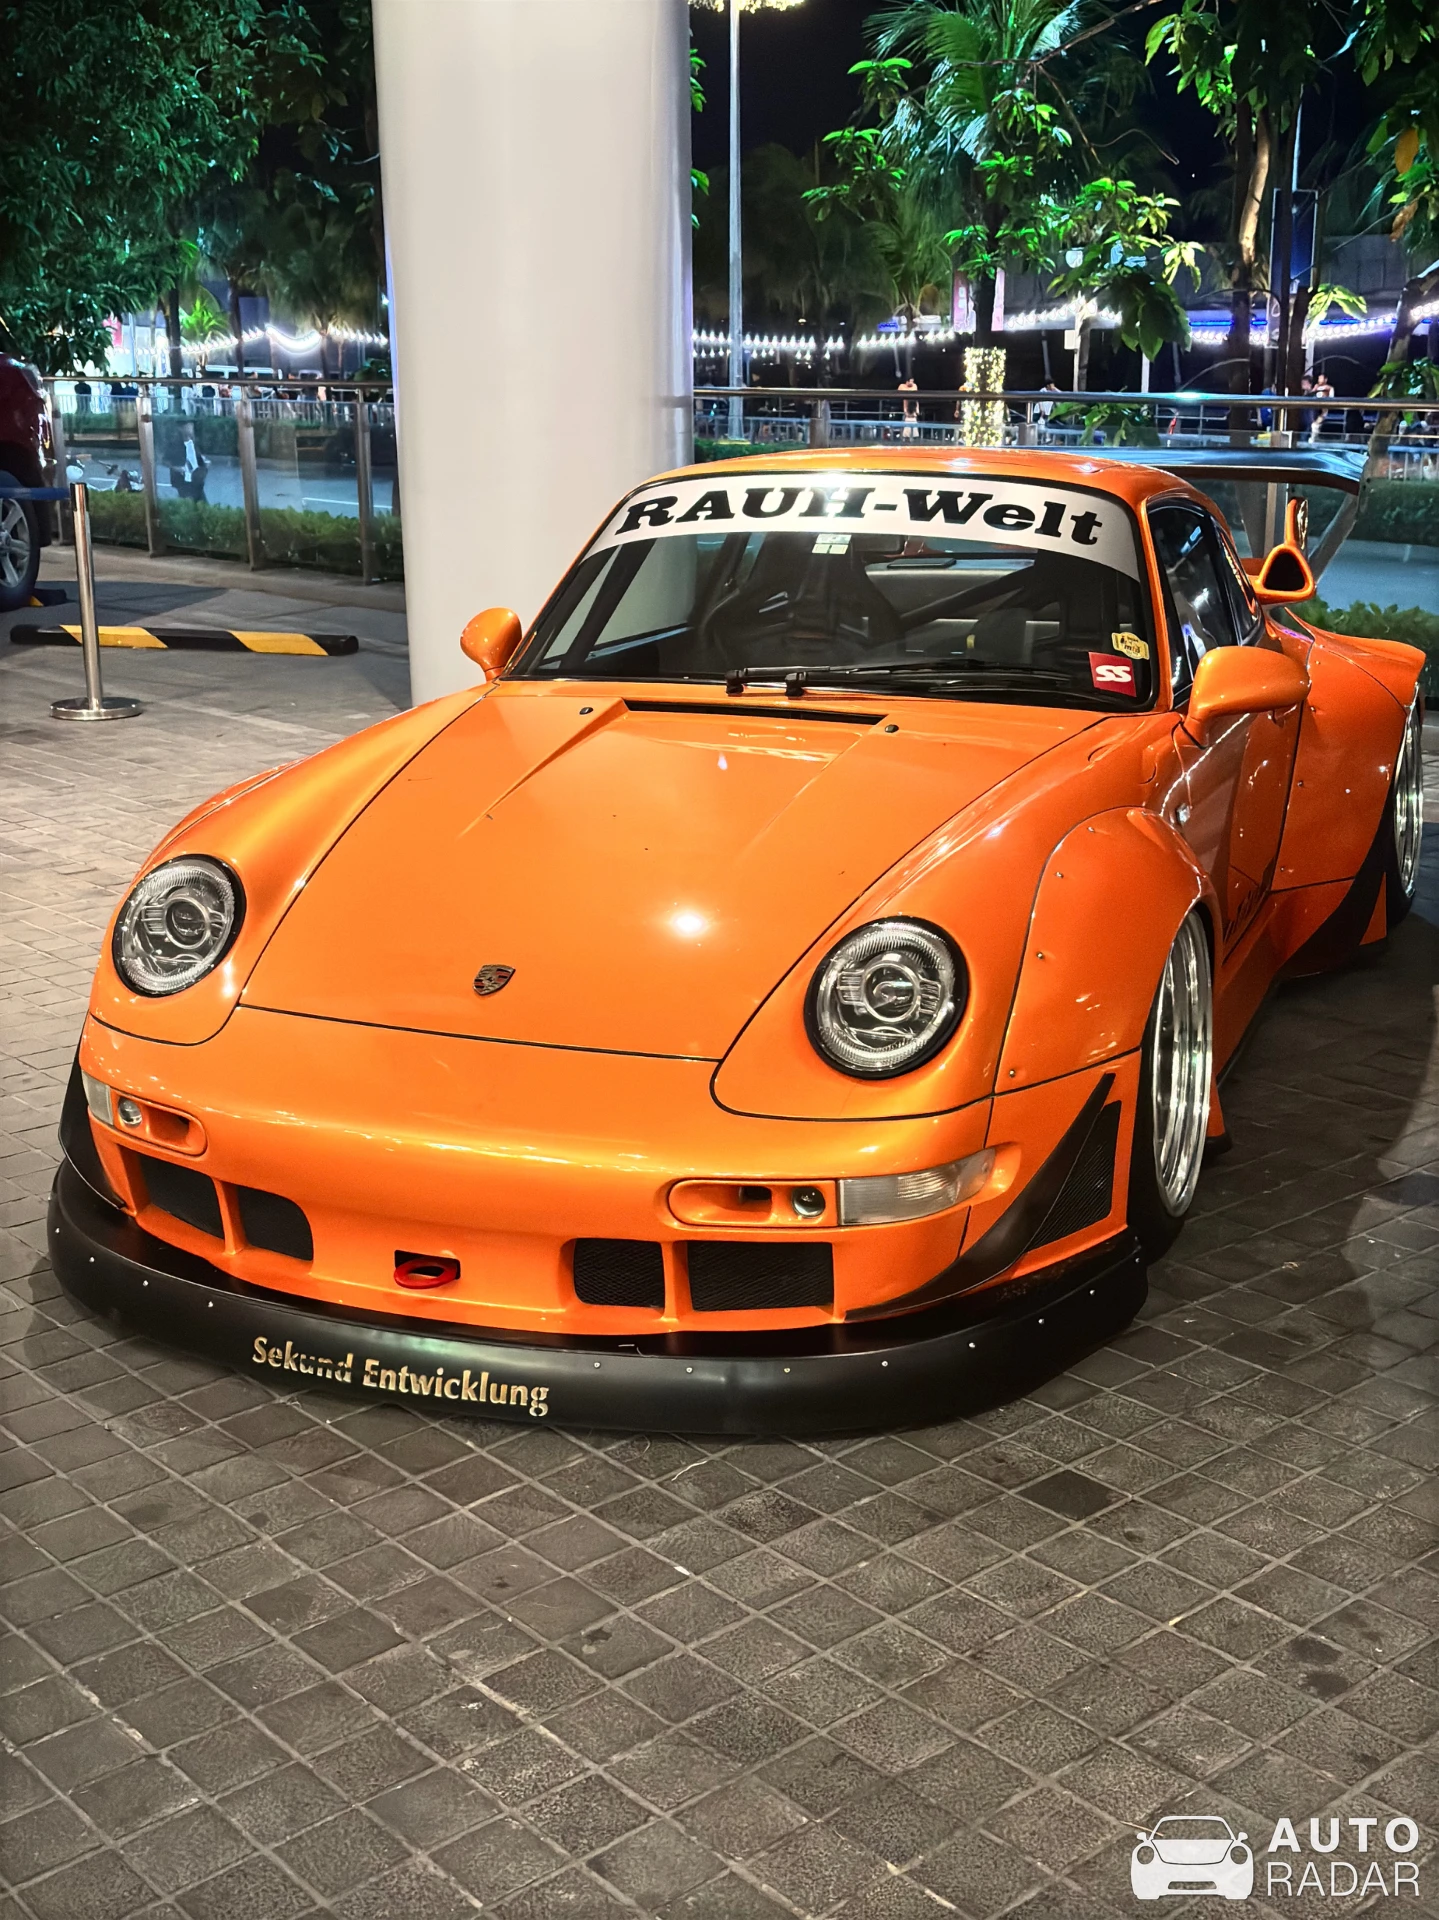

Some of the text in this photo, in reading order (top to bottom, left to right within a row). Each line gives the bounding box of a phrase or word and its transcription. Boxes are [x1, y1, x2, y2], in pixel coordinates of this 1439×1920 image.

[614, 487, 1103, 545] RAUH-Welt
[1096, 665, 1131, 682] SS
[252, 1336, 549, 1417] Sekund Entwicklung
